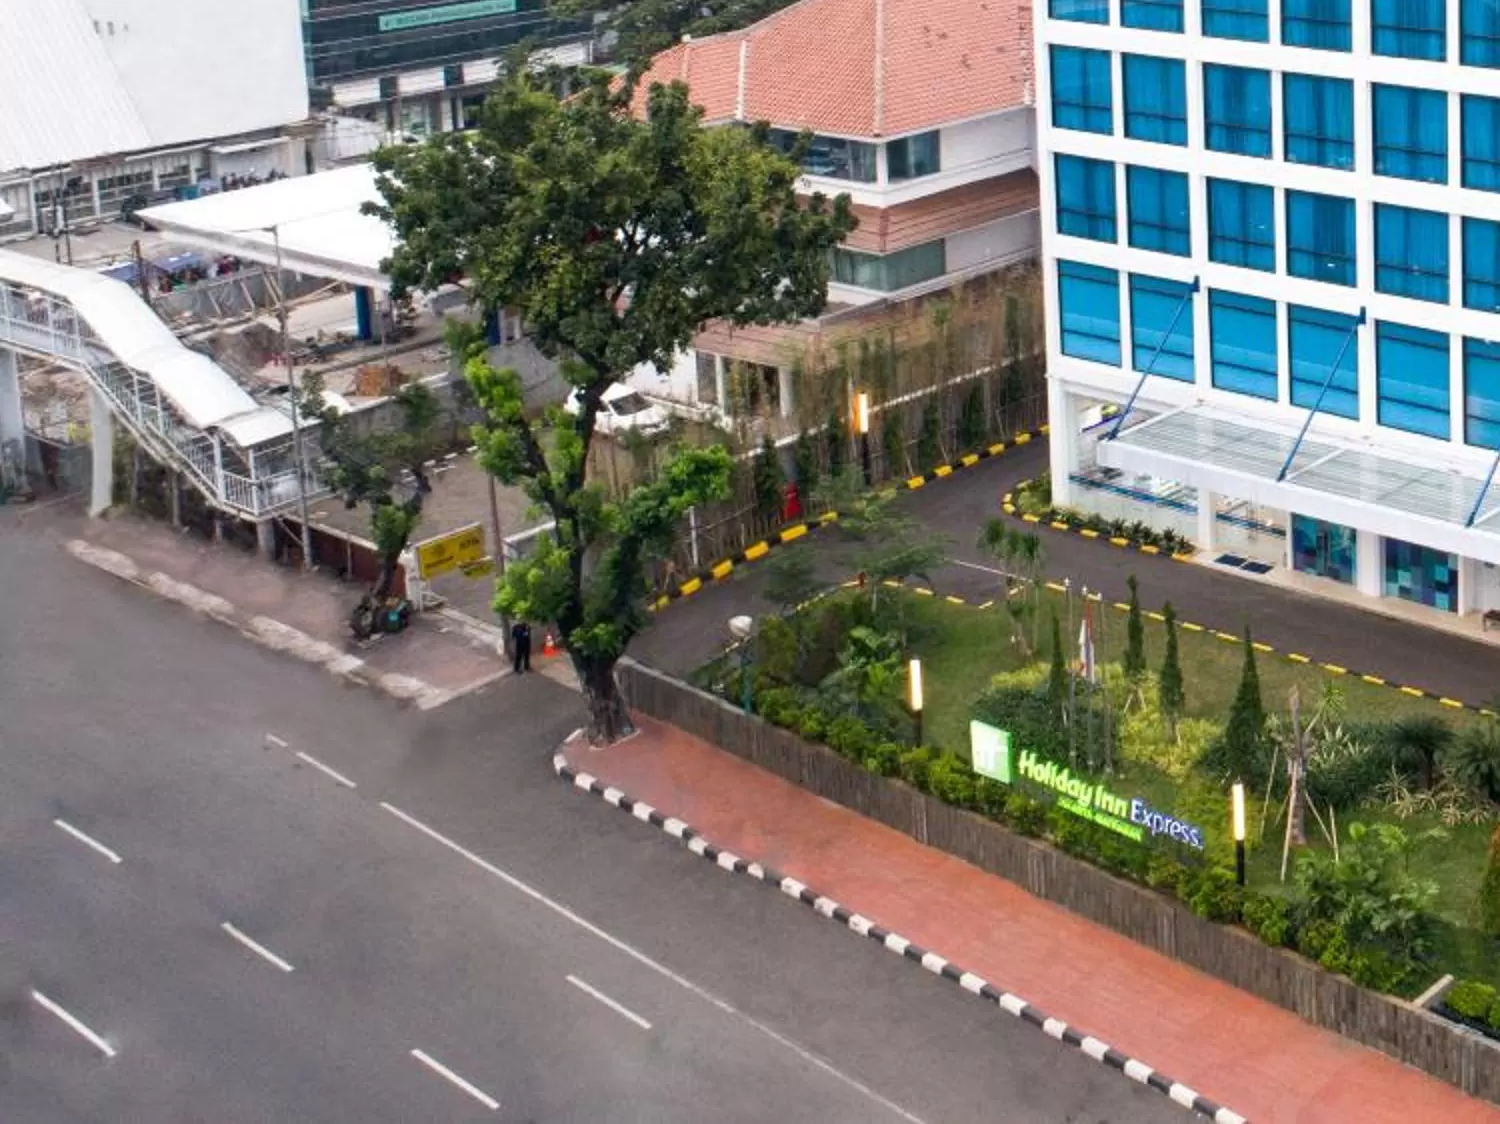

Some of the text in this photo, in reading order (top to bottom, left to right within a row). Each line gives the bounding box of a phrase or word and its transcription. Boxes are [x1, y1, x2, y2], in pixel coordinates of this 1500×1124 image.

[1018, 749, 1093, 807] Holiday
[1094, 784, 1129, 818] Inn
[1130, 797, 1202, 848] Express
